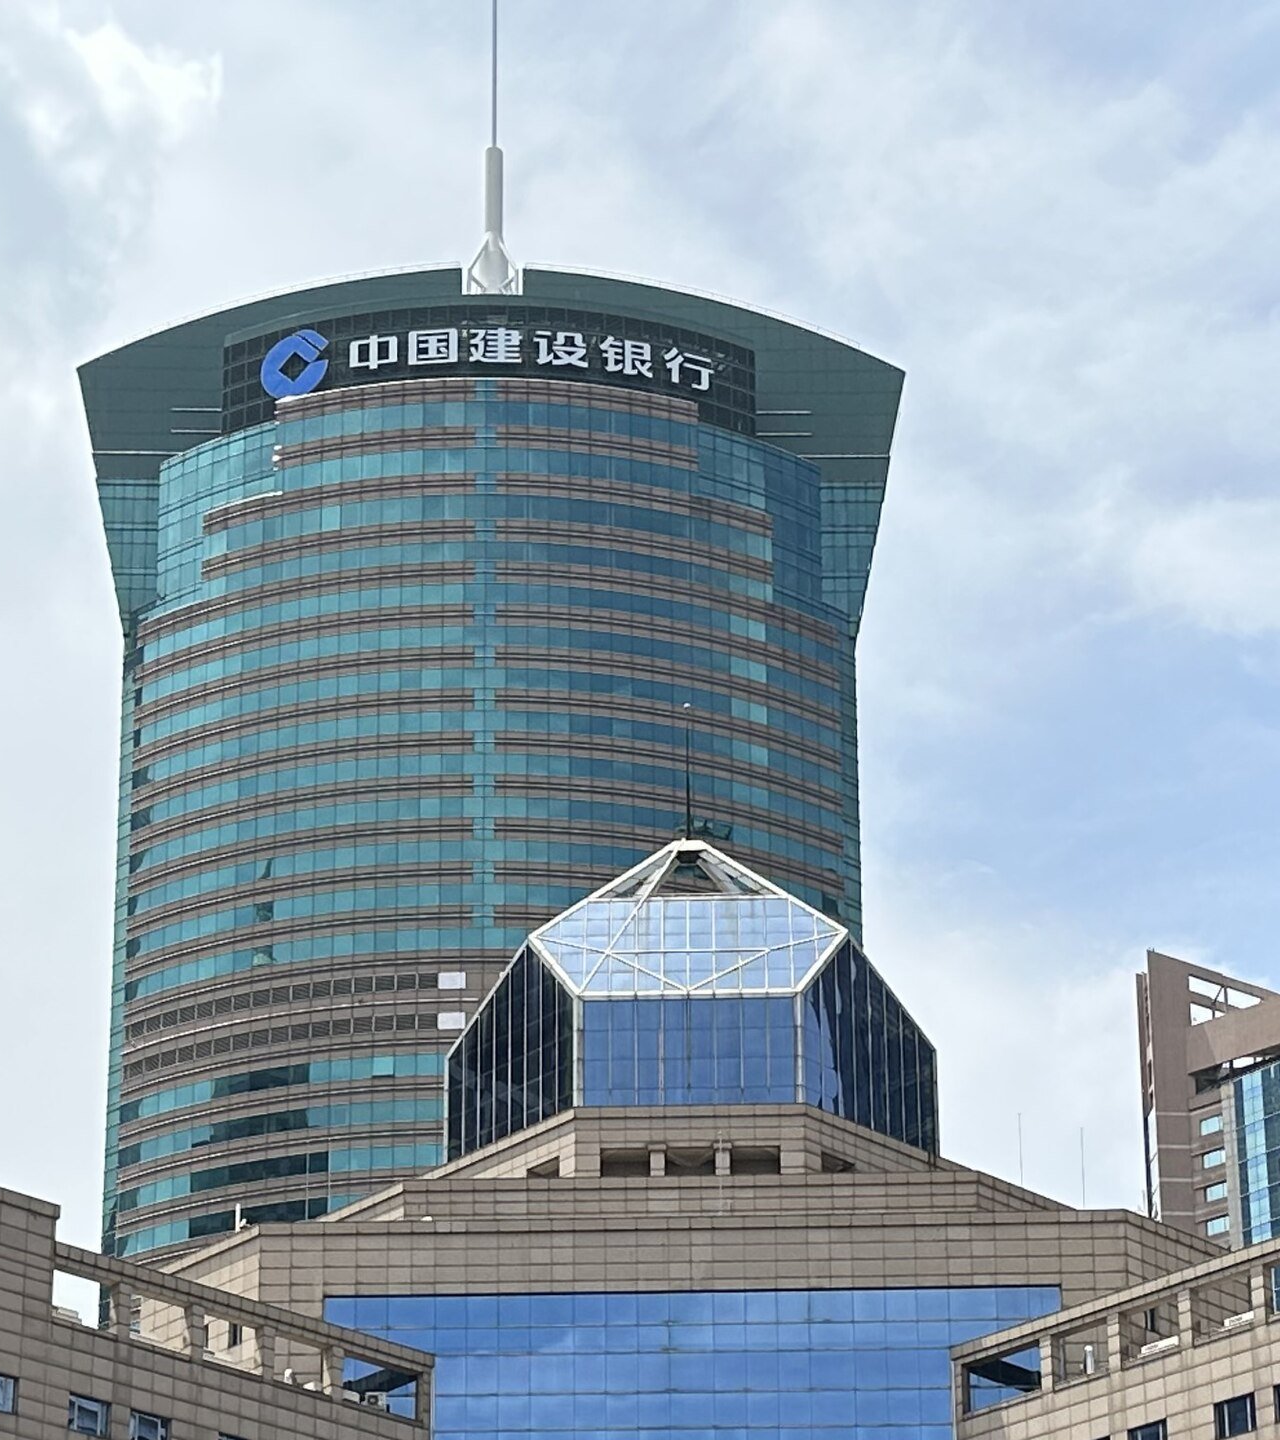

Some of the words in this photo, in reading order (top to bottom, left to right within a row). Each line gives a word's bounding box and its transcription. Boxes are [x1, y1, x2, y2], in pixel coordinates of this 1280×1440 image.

[349, 328, 715, 391] 中国建设银行
